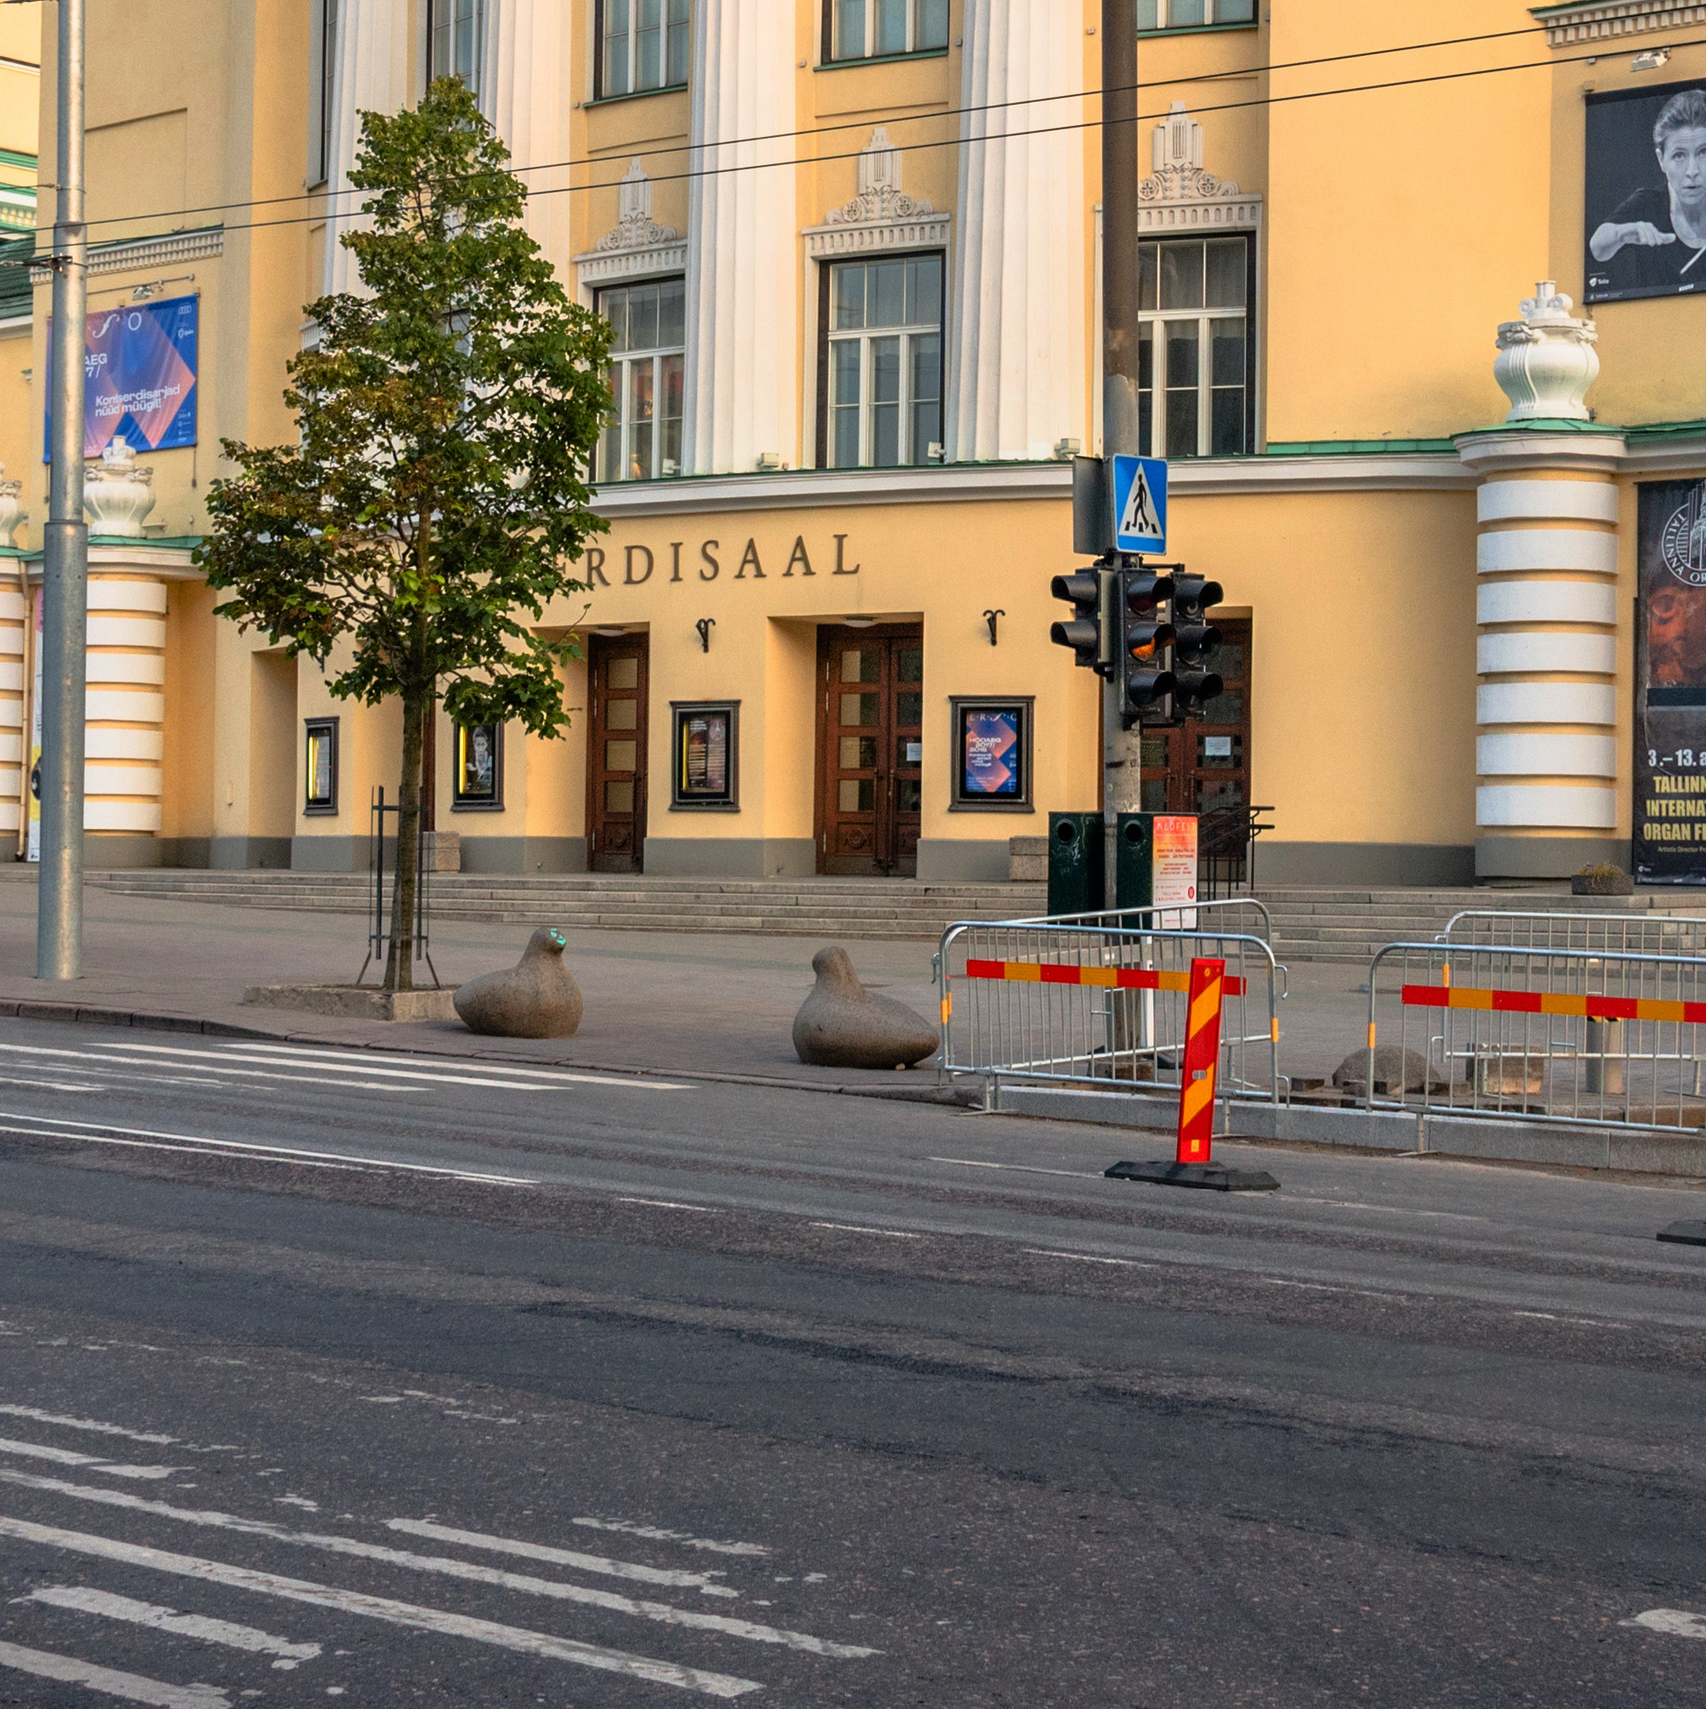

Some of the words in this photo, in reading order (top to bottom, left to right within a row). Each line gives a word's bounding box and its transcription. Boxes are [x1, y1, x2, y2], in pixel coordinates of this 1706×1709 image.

[85, 353, 107, 366] AEG
[95, 384, 180, 407] Kontserdisarjad
[95, 403, 119, 417] nüüd
[121, 398, 162, 414] müügil!
[1666, 513, 1687, 576] TALLINNA
[1643, 823, 1691, 841] ORGAN
